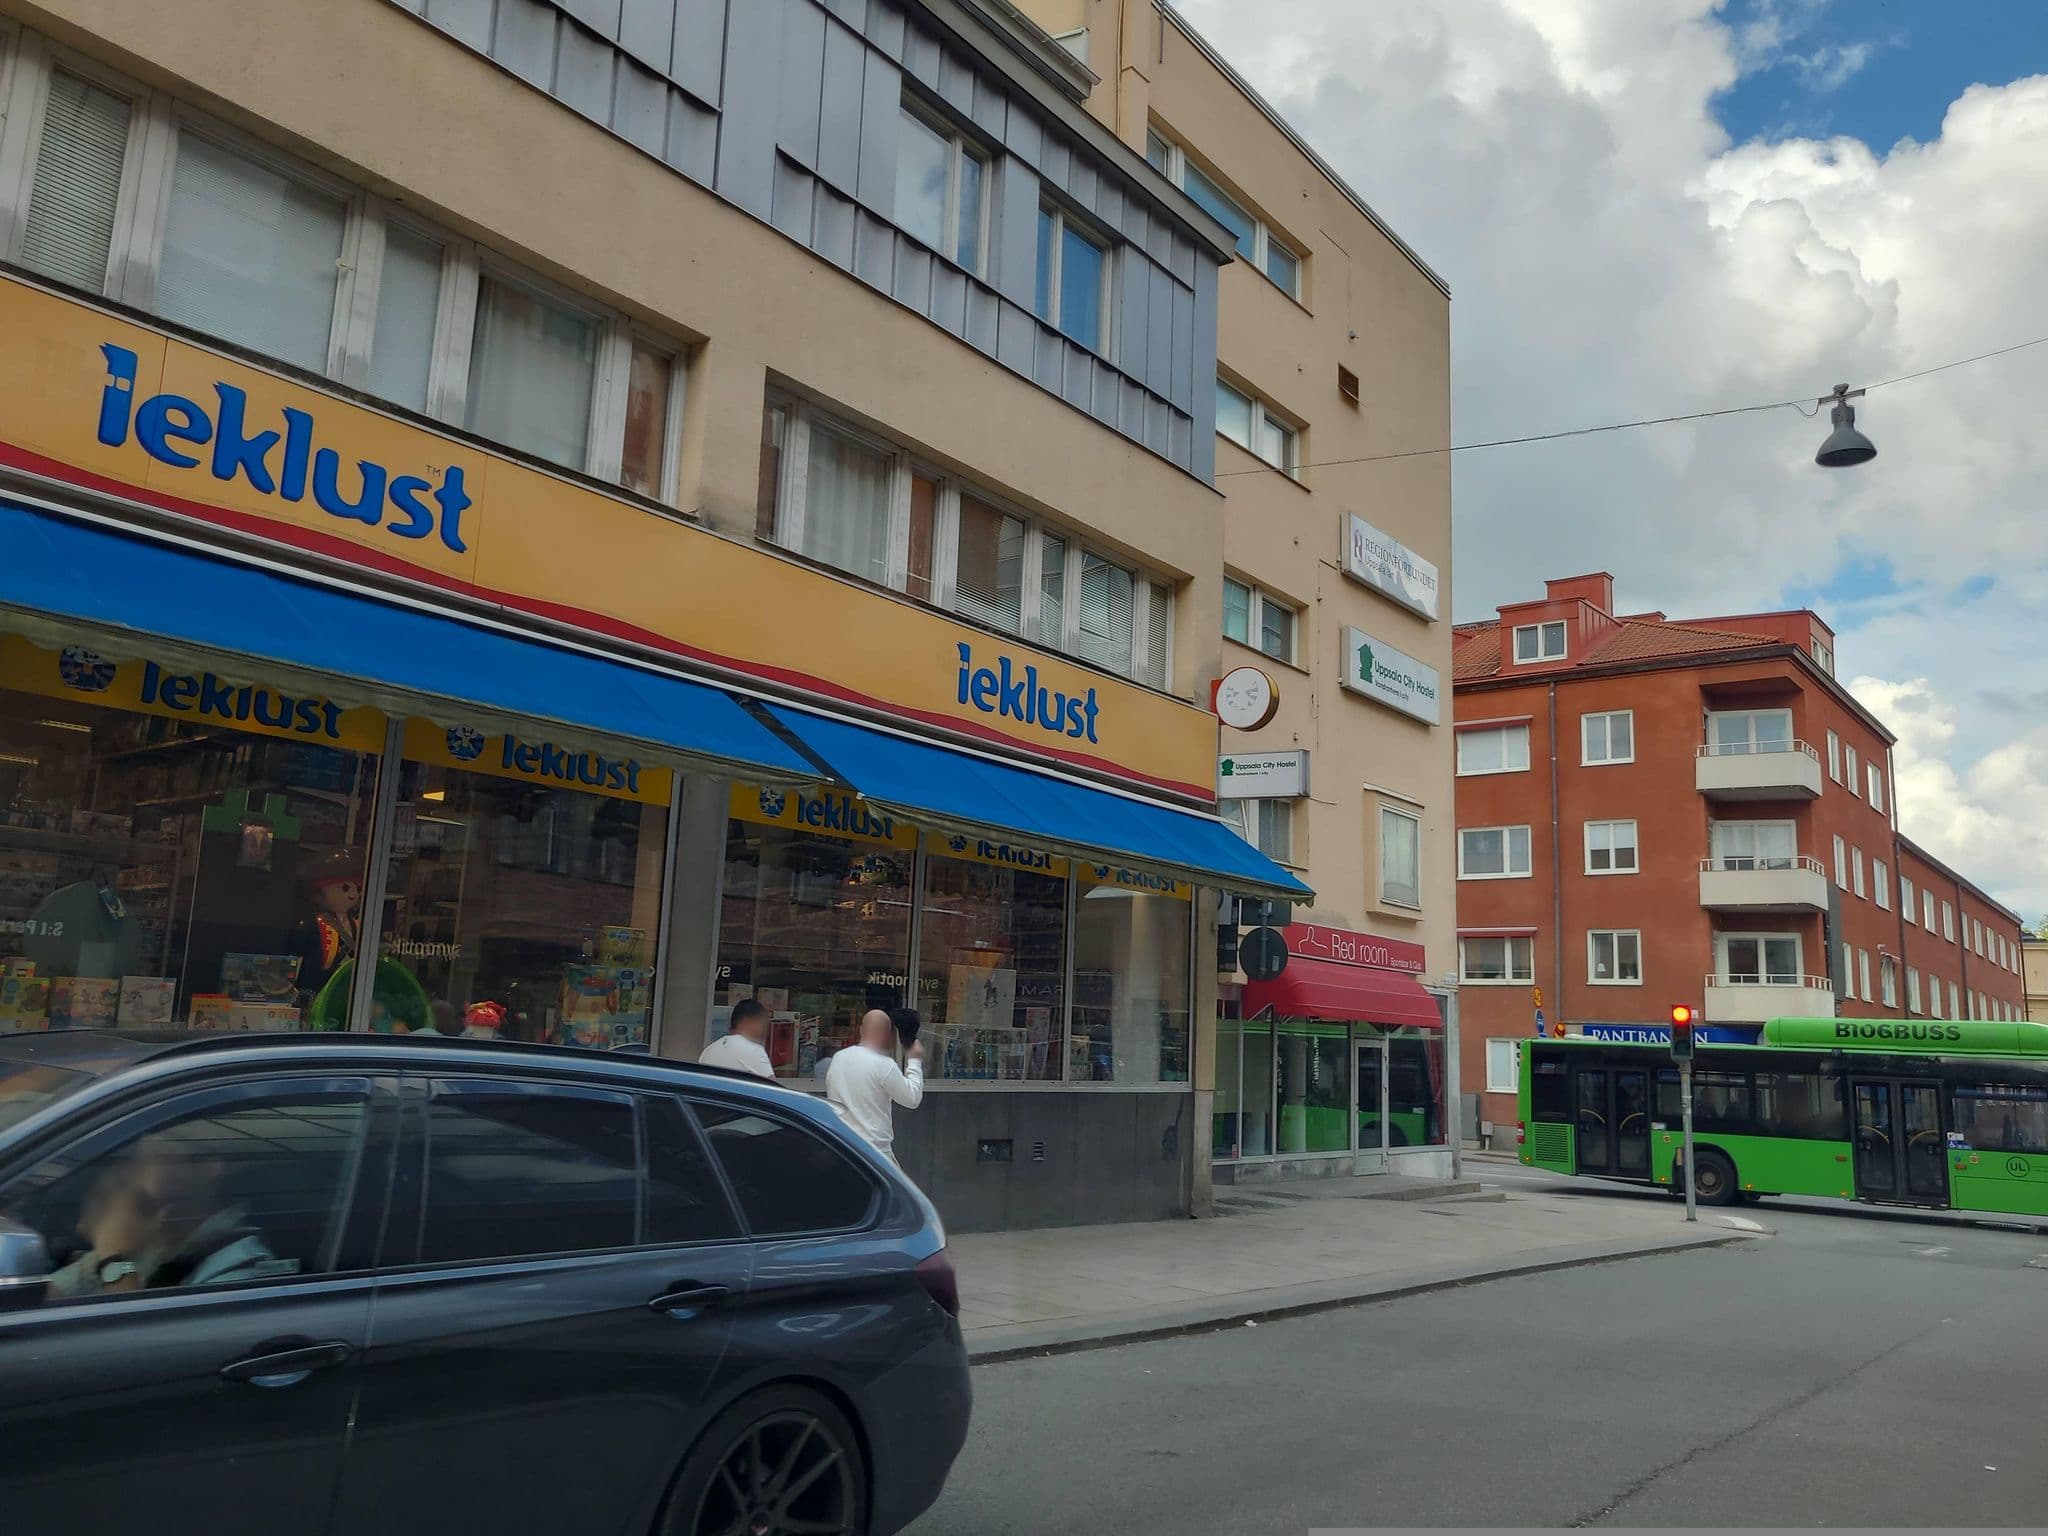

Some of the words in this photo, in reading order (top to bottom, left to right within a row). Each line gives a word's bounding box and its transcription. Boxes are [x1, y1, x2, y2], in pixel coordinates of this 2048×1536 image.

[1374, 659, 1403, 684] Uppsala
[1403, 674, 1416, 693] City
[1416, 680, 1436, 700] Hostel
[1235, 762, 1262, 770] Uppsala
[1262, 761, 1276, 769] City
[1276, 760, 1297, 768] Hostel
[1331, 933, 1356, 960] Red
[1359, 944, 1388, 965] room
[1592, 1029, 1709, 1044] PANTBANN
[2010, 1161, 2027, 1172] UL
